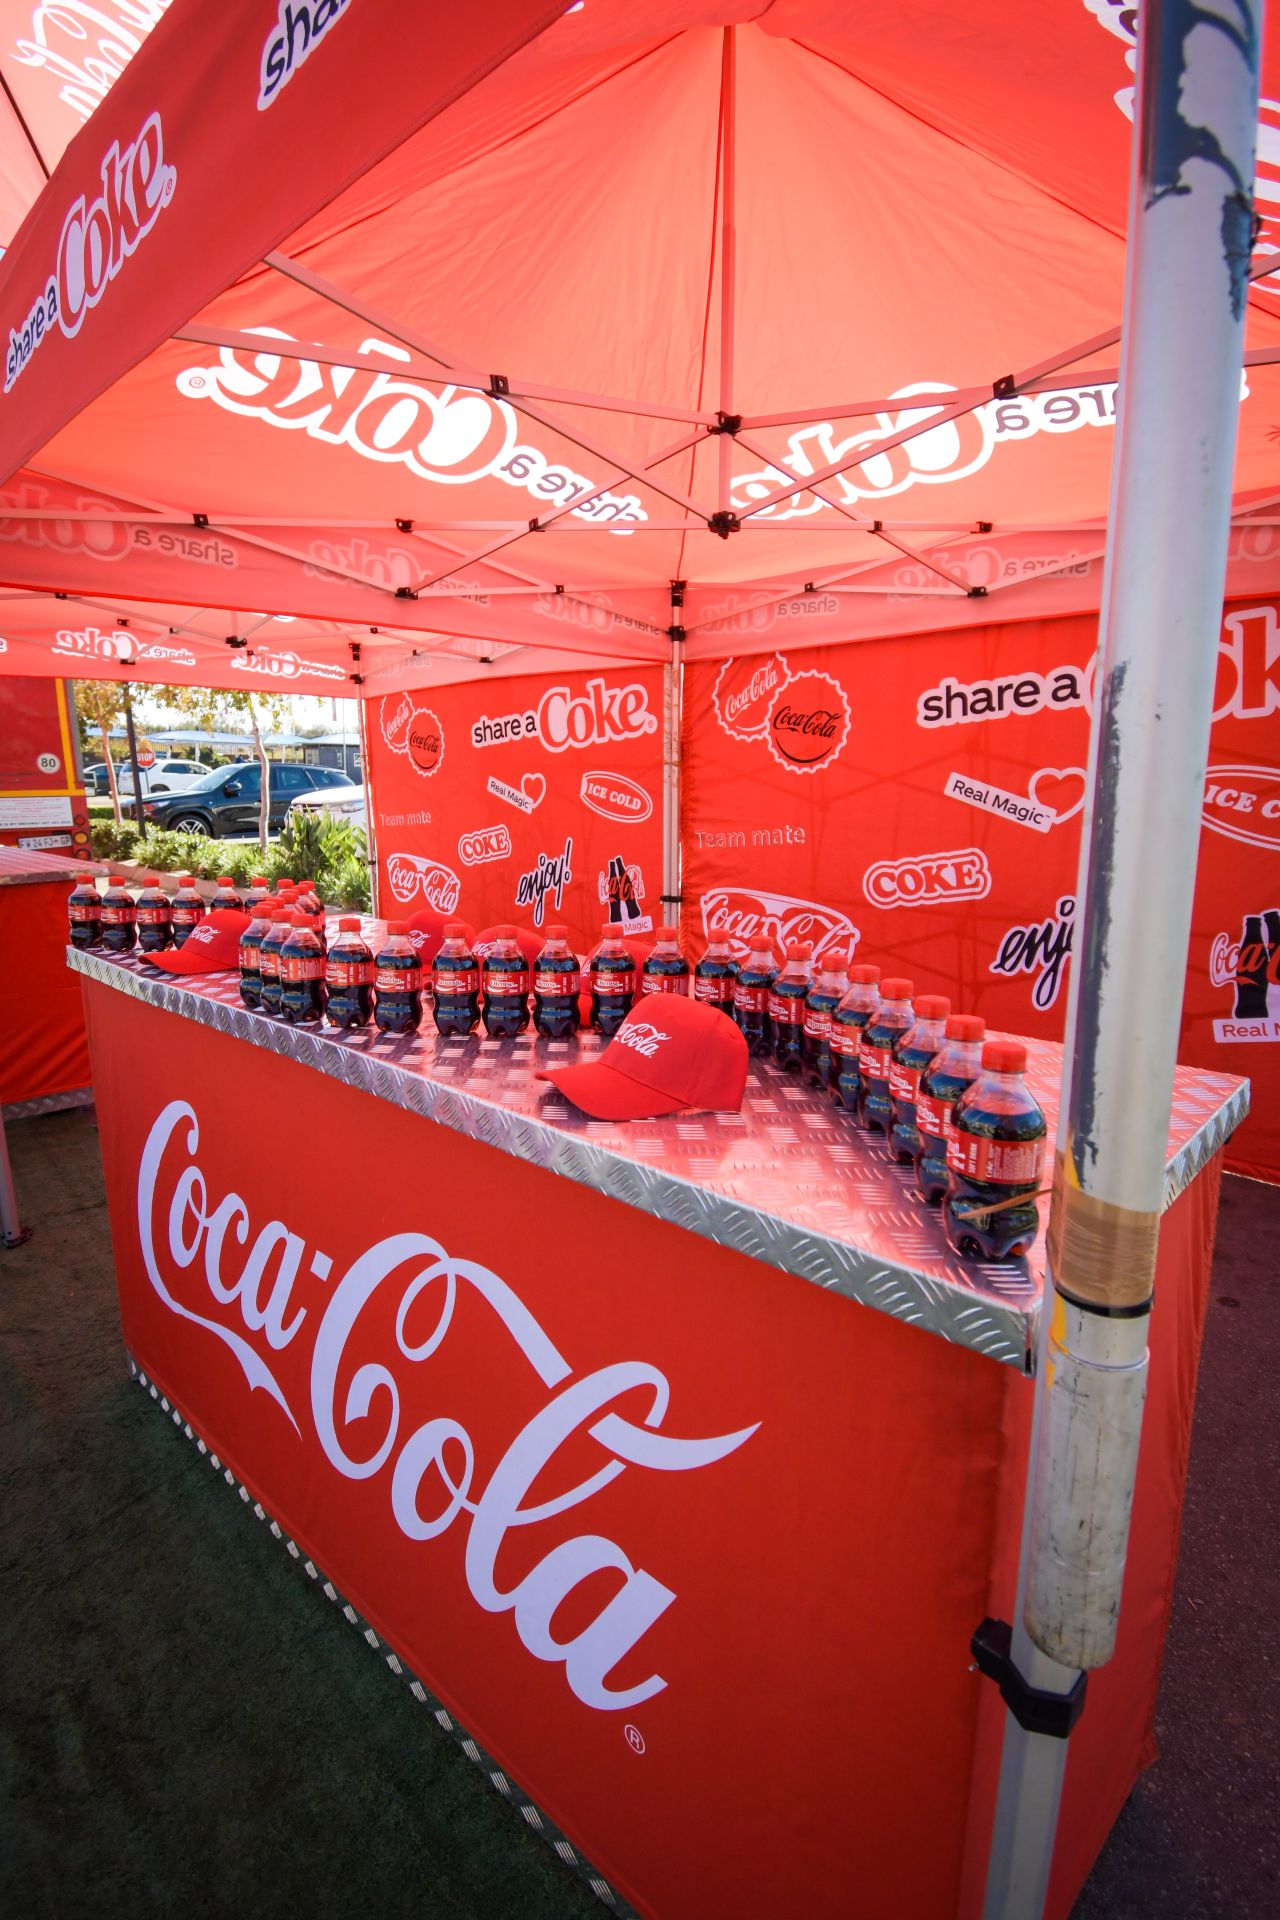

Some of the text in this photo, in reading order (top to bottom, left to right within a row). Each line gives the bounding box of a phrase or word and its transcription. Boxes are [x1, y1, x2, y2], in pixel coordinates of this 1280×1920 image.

[7, 112, 165, 385] share a Coke
[922, 669, 1081, 722] share a
[474, 678, 649, 753] share a Coke
[41, 757, 56, 768] 80
[490, 780, 529, 810] Real Magic
[587, 782, 642, 811] ICE COLD
[952, 778, 1046, 826] Real Magic
[1204, 784, 1257, 814] ICE
[380, 809, 432, 828] Team mate
[462, 831, 508, 861] COKE
[694, 823, 806, 849] Team mate
[517, 838, 573, 926] enjoy!
[871, 860, 982, 901] COKE
[624, 921, 648, 933] Magic
[1222, 1022, 1267, 1039] Real
[138, 1100, 762, 1710] Coca-Cola
